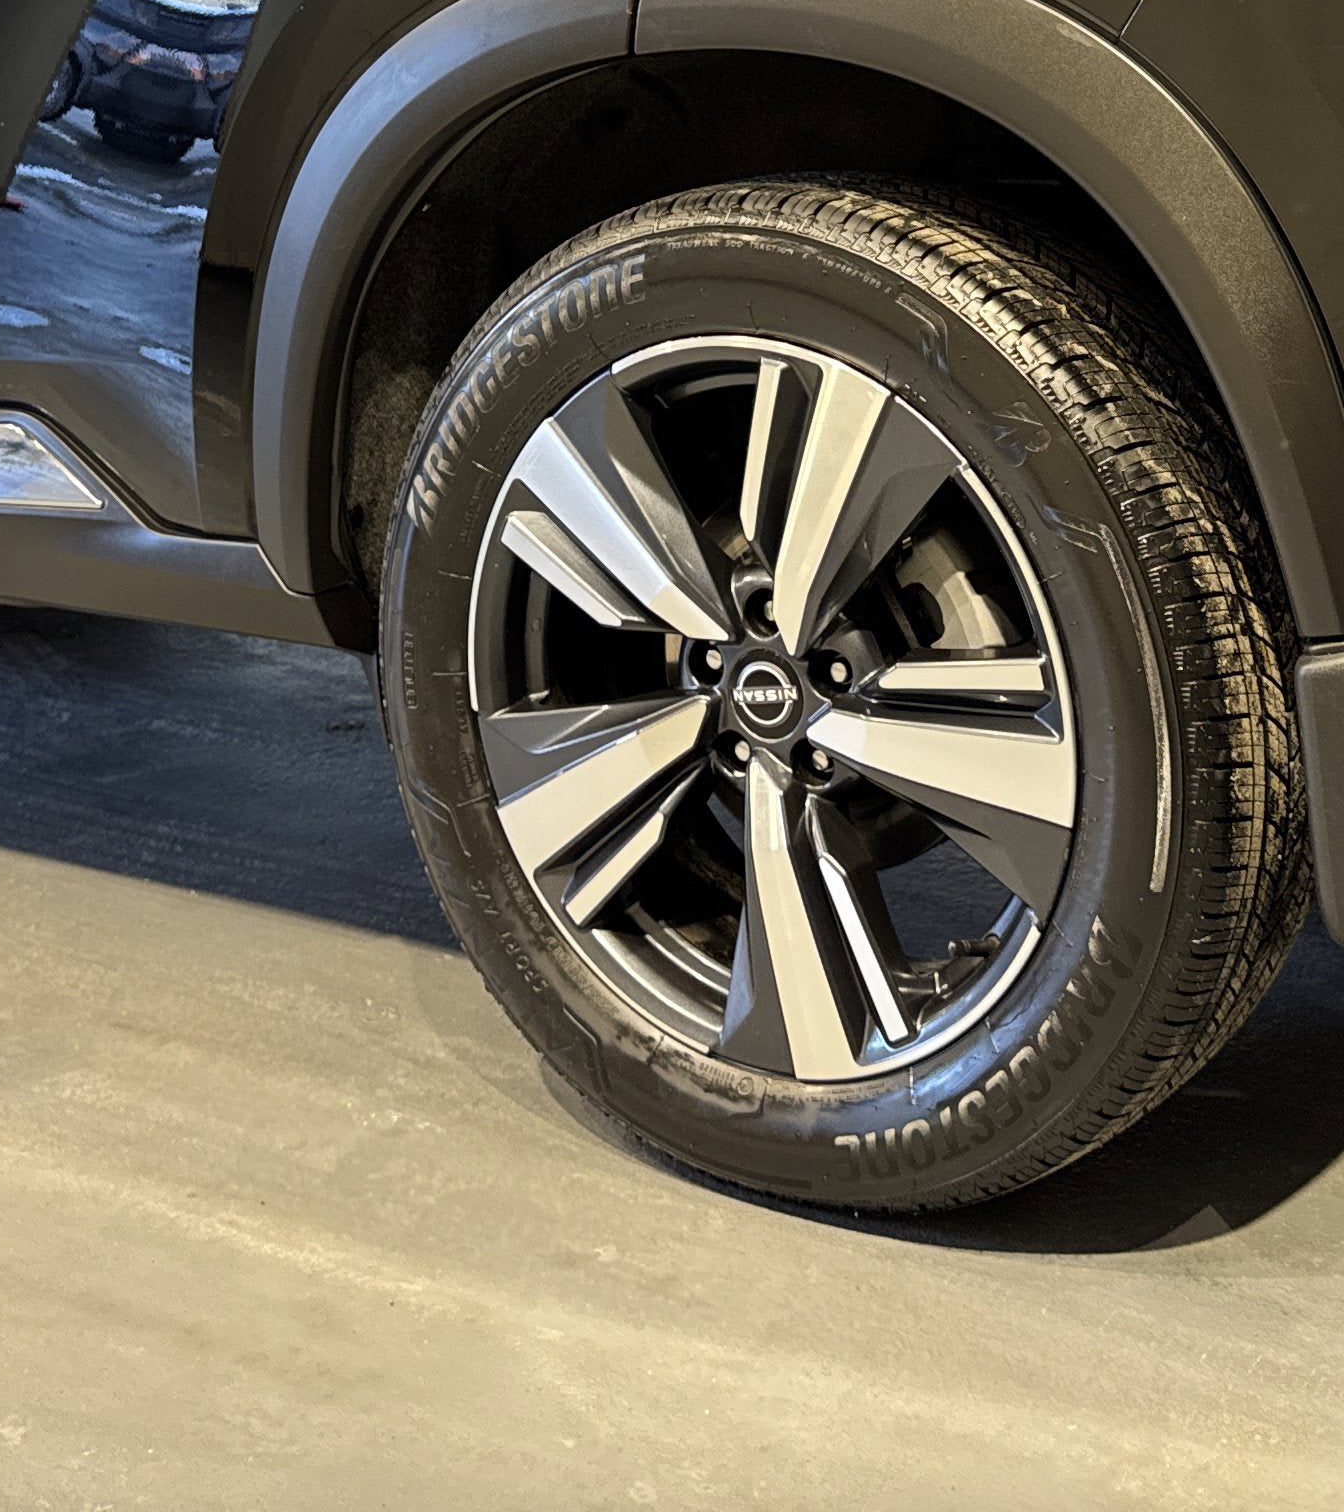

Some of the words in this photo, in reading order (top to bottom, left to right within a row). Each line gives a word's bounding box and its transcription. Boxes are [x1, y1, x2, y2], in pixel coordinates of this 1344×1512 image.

[406, 253, 646, 538] BRIDGESTONE
[733, 687, 798, 702] NISSAN
[834, 914, 1142, 1181] BRIDGESTONE
